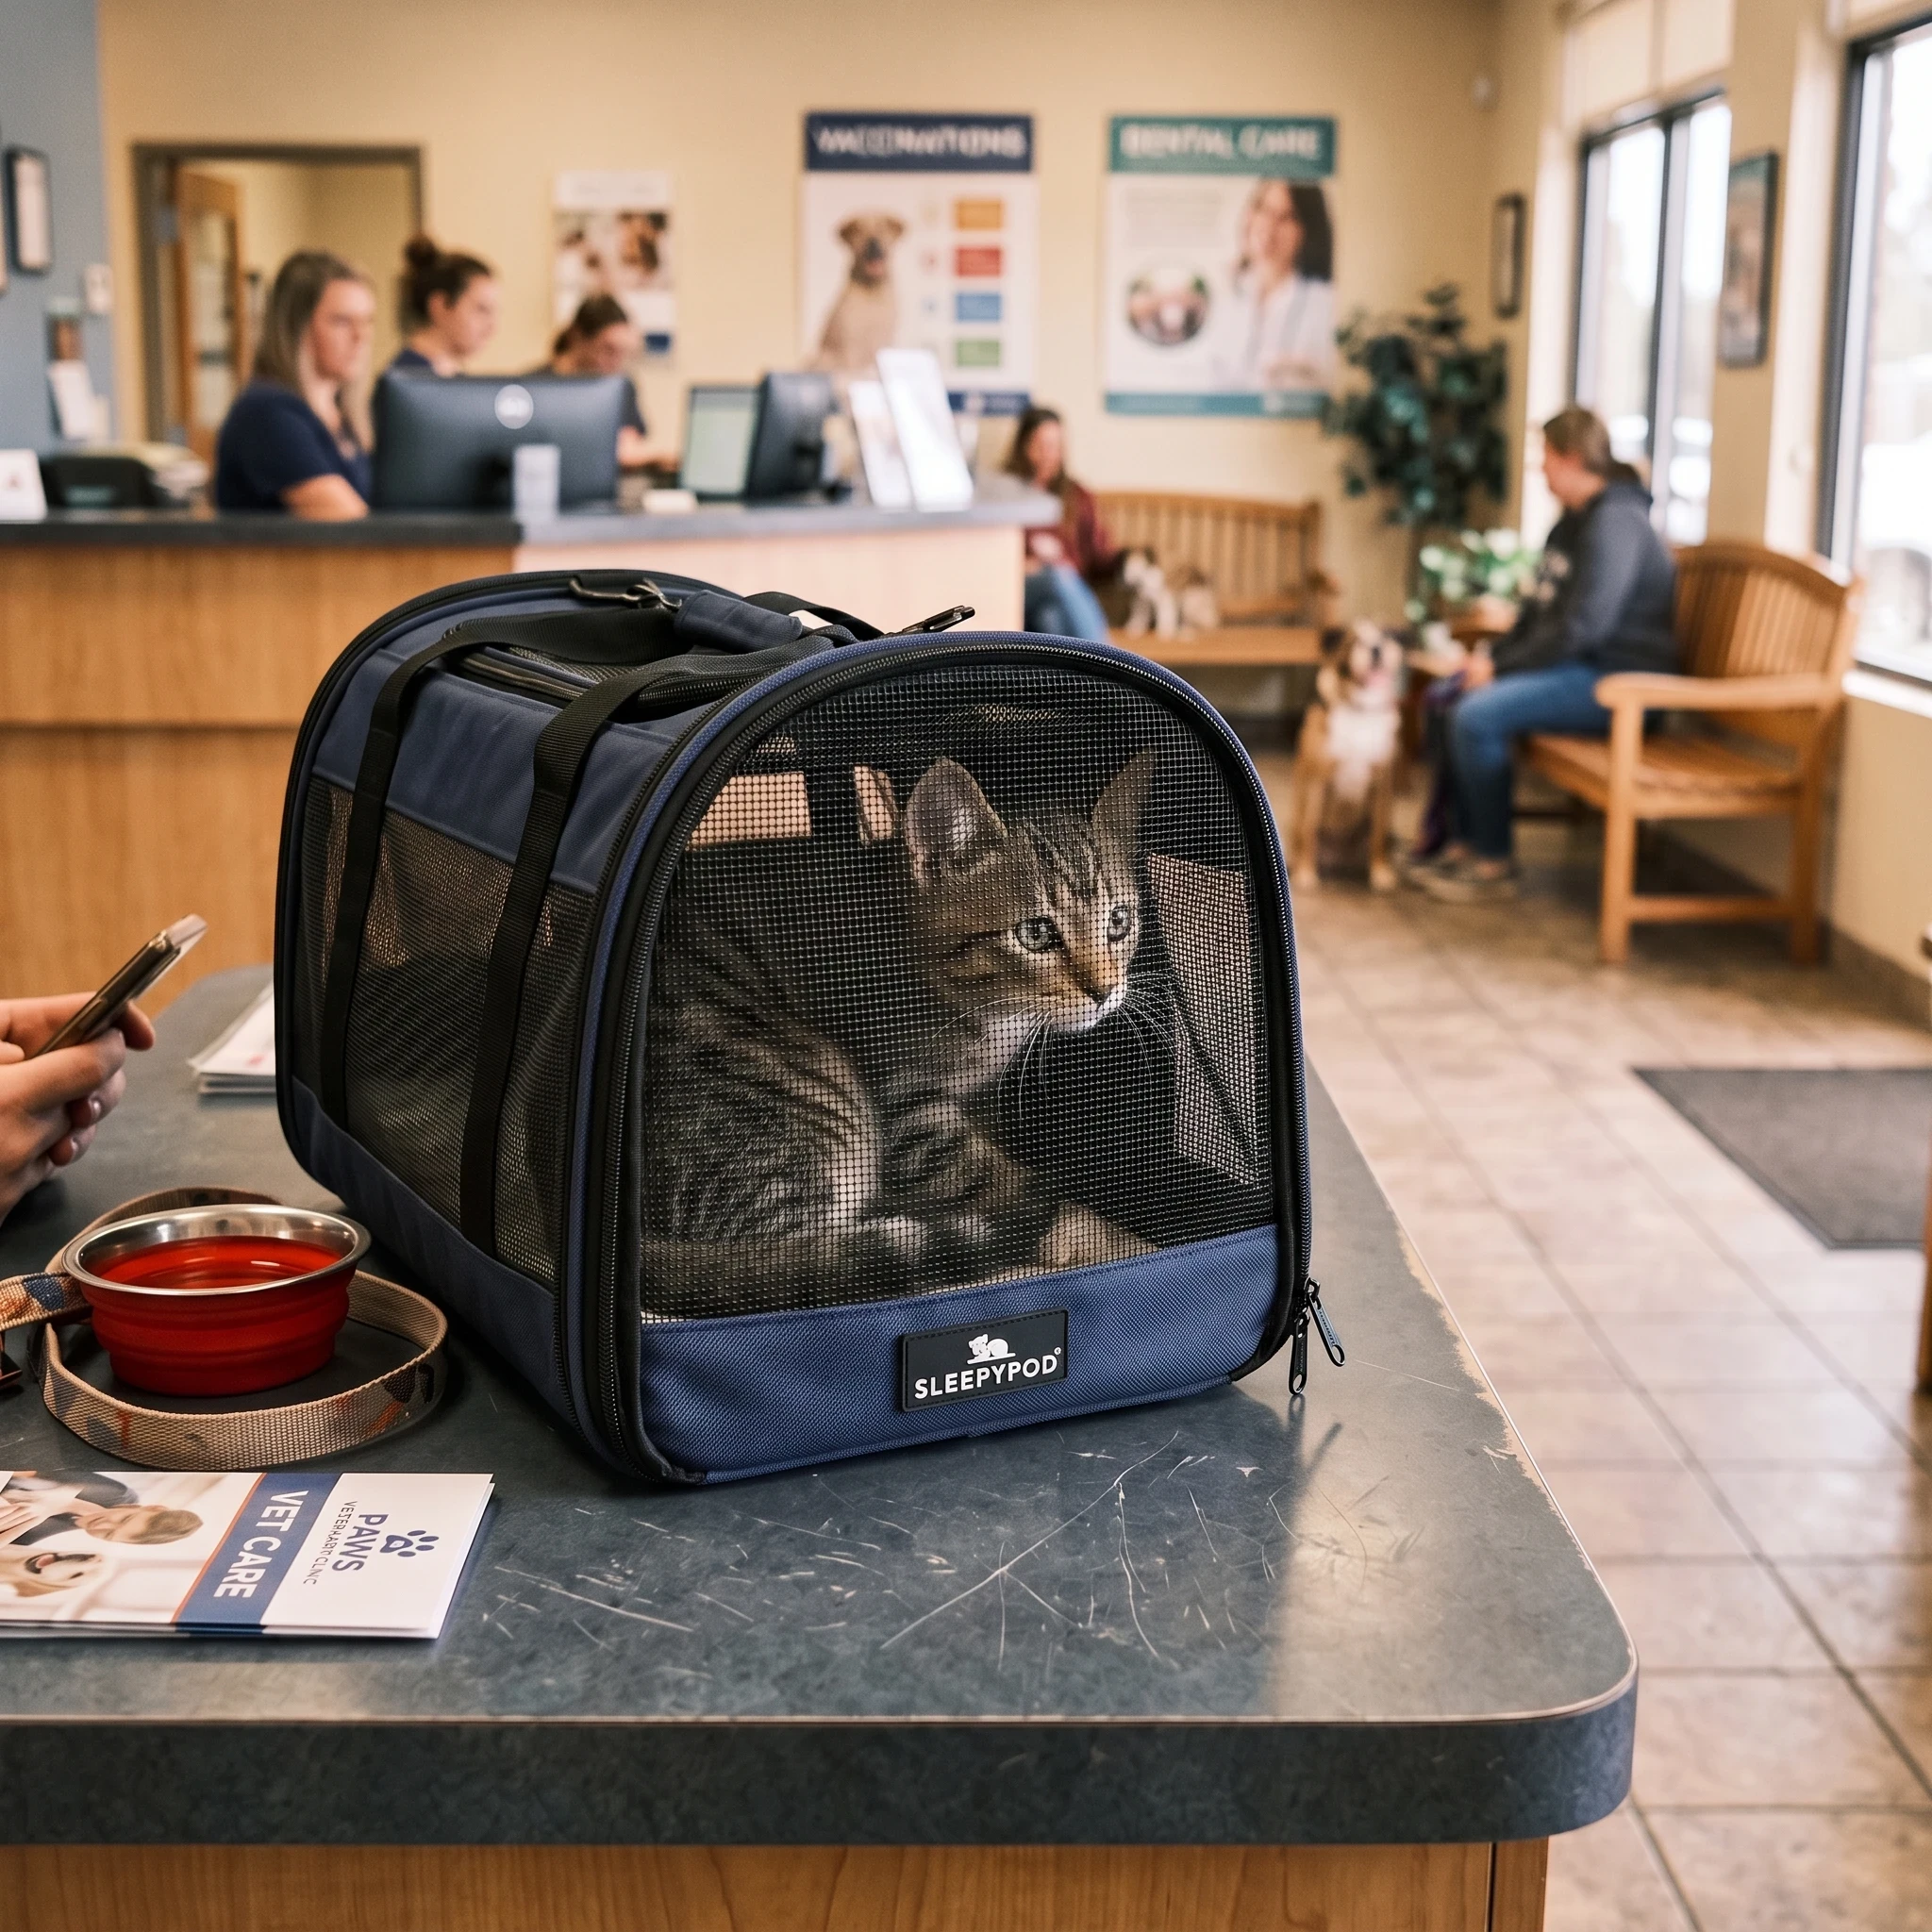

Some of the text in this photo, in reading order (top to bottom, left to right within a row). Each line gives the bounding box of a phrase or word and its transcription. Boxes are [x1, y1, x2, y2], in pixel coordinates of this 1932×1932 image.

[213, 1490, 309, 1598] VET CARE
[332, 1513, 389, 1572] PAWS
